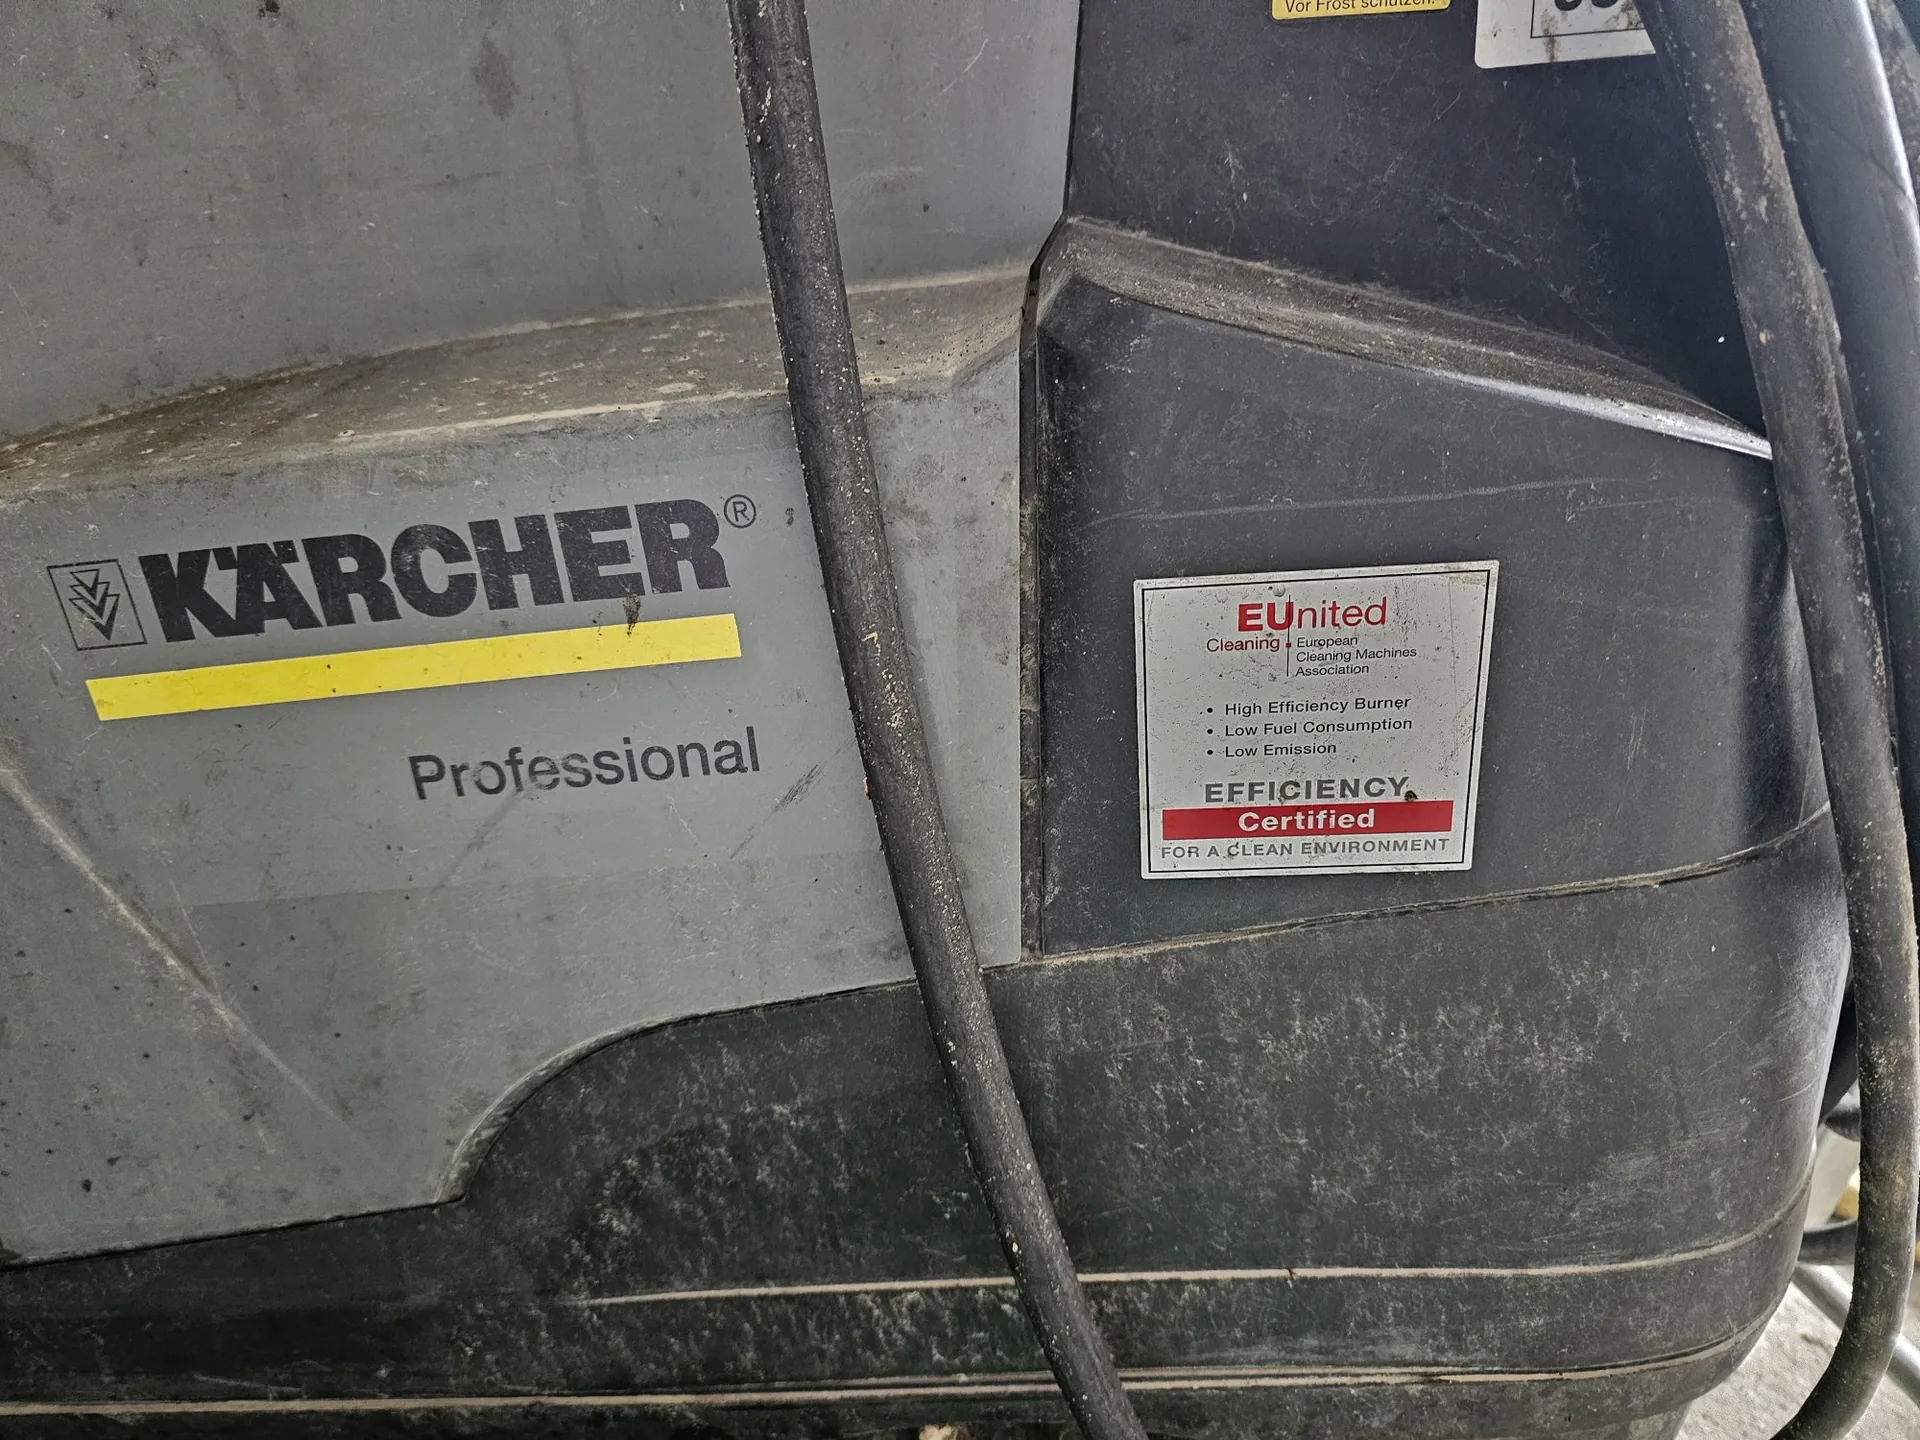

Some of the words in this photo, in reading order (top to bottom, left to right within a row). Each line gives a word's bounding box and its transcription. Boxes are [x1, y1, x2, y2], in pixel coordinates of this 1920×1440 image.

[1285, 0, 1311, 13] Vor
[1316, 0, 1355, 11] Frost
[139, 499, 731, 642] KÄRCHER
[1237, 596, 1388, 632] EUnited
[1206, 637, 1280, 653] Cleaning
[1296, 635, 1358, 650] European
[1296, 650, 1351, 664] Cleaning
[1355, 647, 1417, 660] Machines
[1295, 664, 1370, 677] Association
[1225, 703, 1262, 718] High
[1268, 700, 1349, 714] Efficiency
[1355, 697, 1411, 710] Burner
[1225, 725, 1258, 737] Low
[1264, 722, 1297, 735] Fuel
[1303, 718, 1413, 733] Consumption
[1225, 746, 1258, 758] Low
[1264, 743, 1337, 757] Emission
[409, 726, 760, 800] Professional
[1205, 776, 1409, 803] EFFICIENCY
[1238, 808, 1376, 832] Certified
[1161, 846, 1200, 859] FOR
[1207, 845, 1221, 858] A
[1227, 843, 1293, 857] CLEAN
[1301, 838, 1450, 855] ENVIRONMENT
